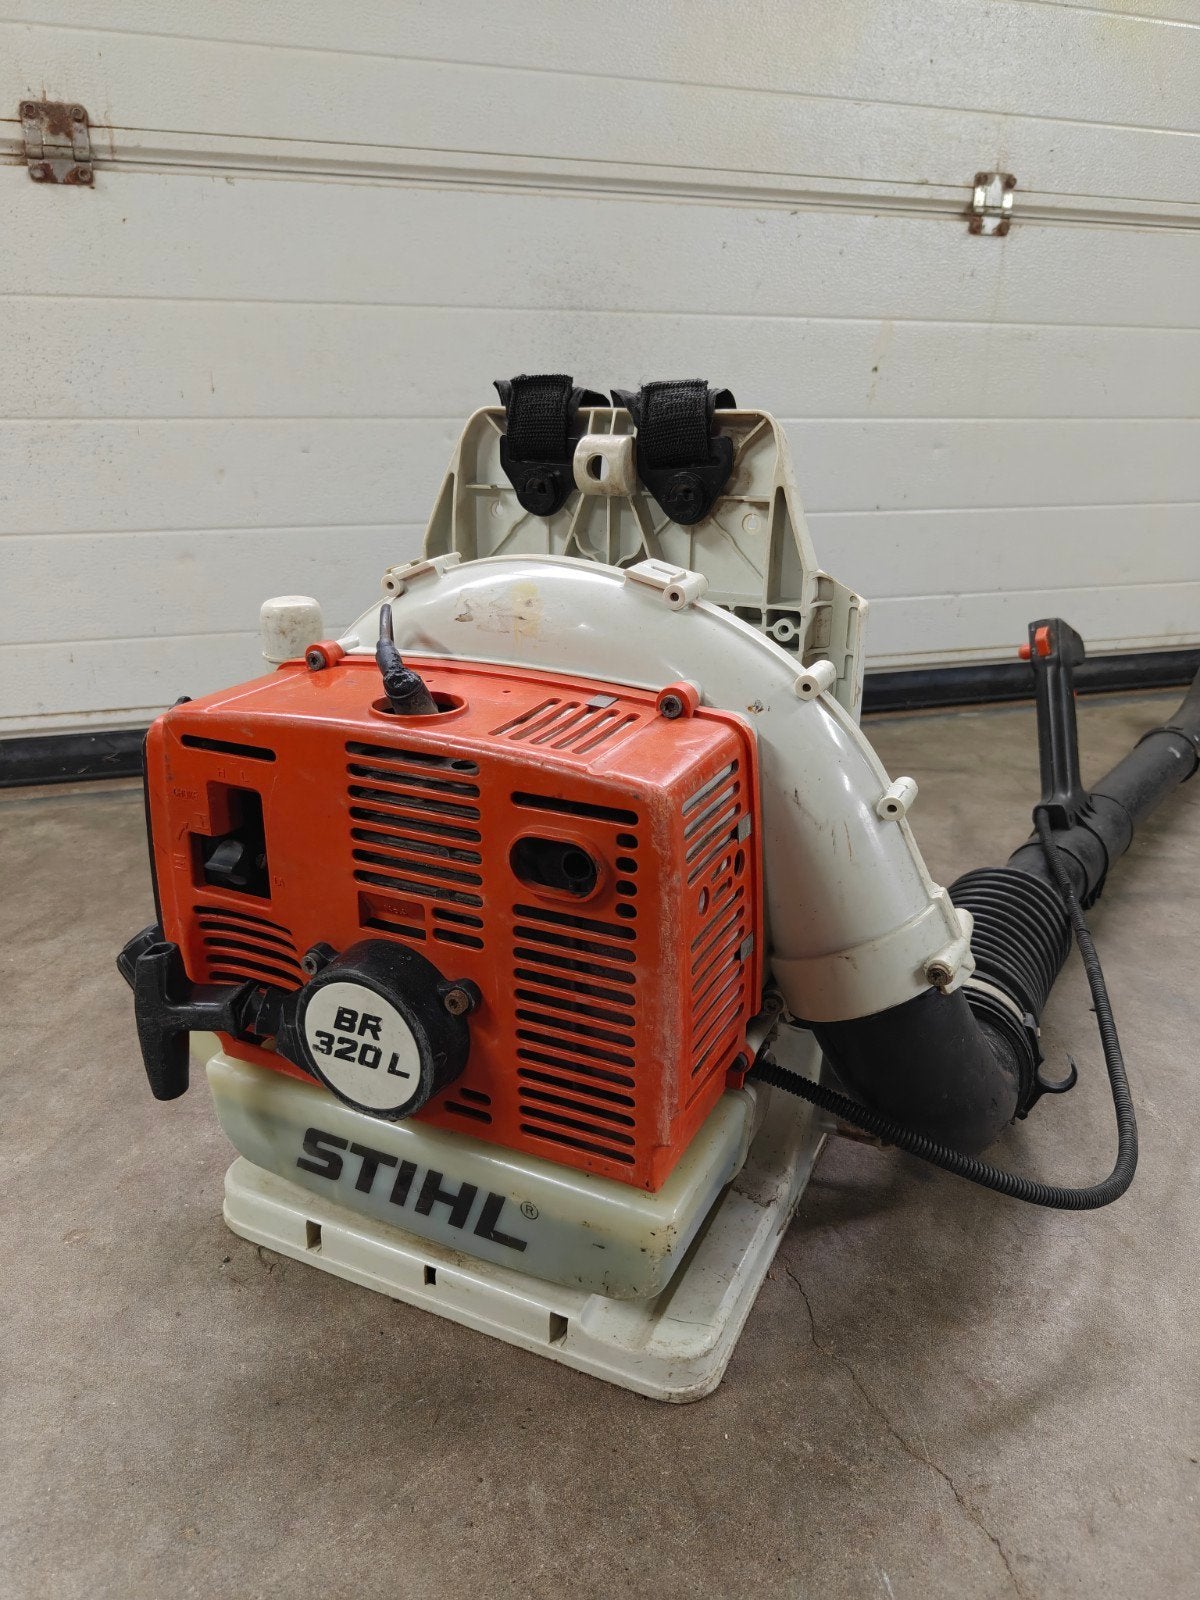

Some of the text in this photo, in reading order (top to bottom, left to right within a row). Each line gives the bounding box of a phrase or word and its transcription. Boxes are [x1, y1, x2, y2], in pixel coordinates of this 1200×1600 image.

[334, 1006, 382, 1041] BR
[312, 1030, 411, 1079] 320 L
[296, 1127, 528, 1252] STIHL
